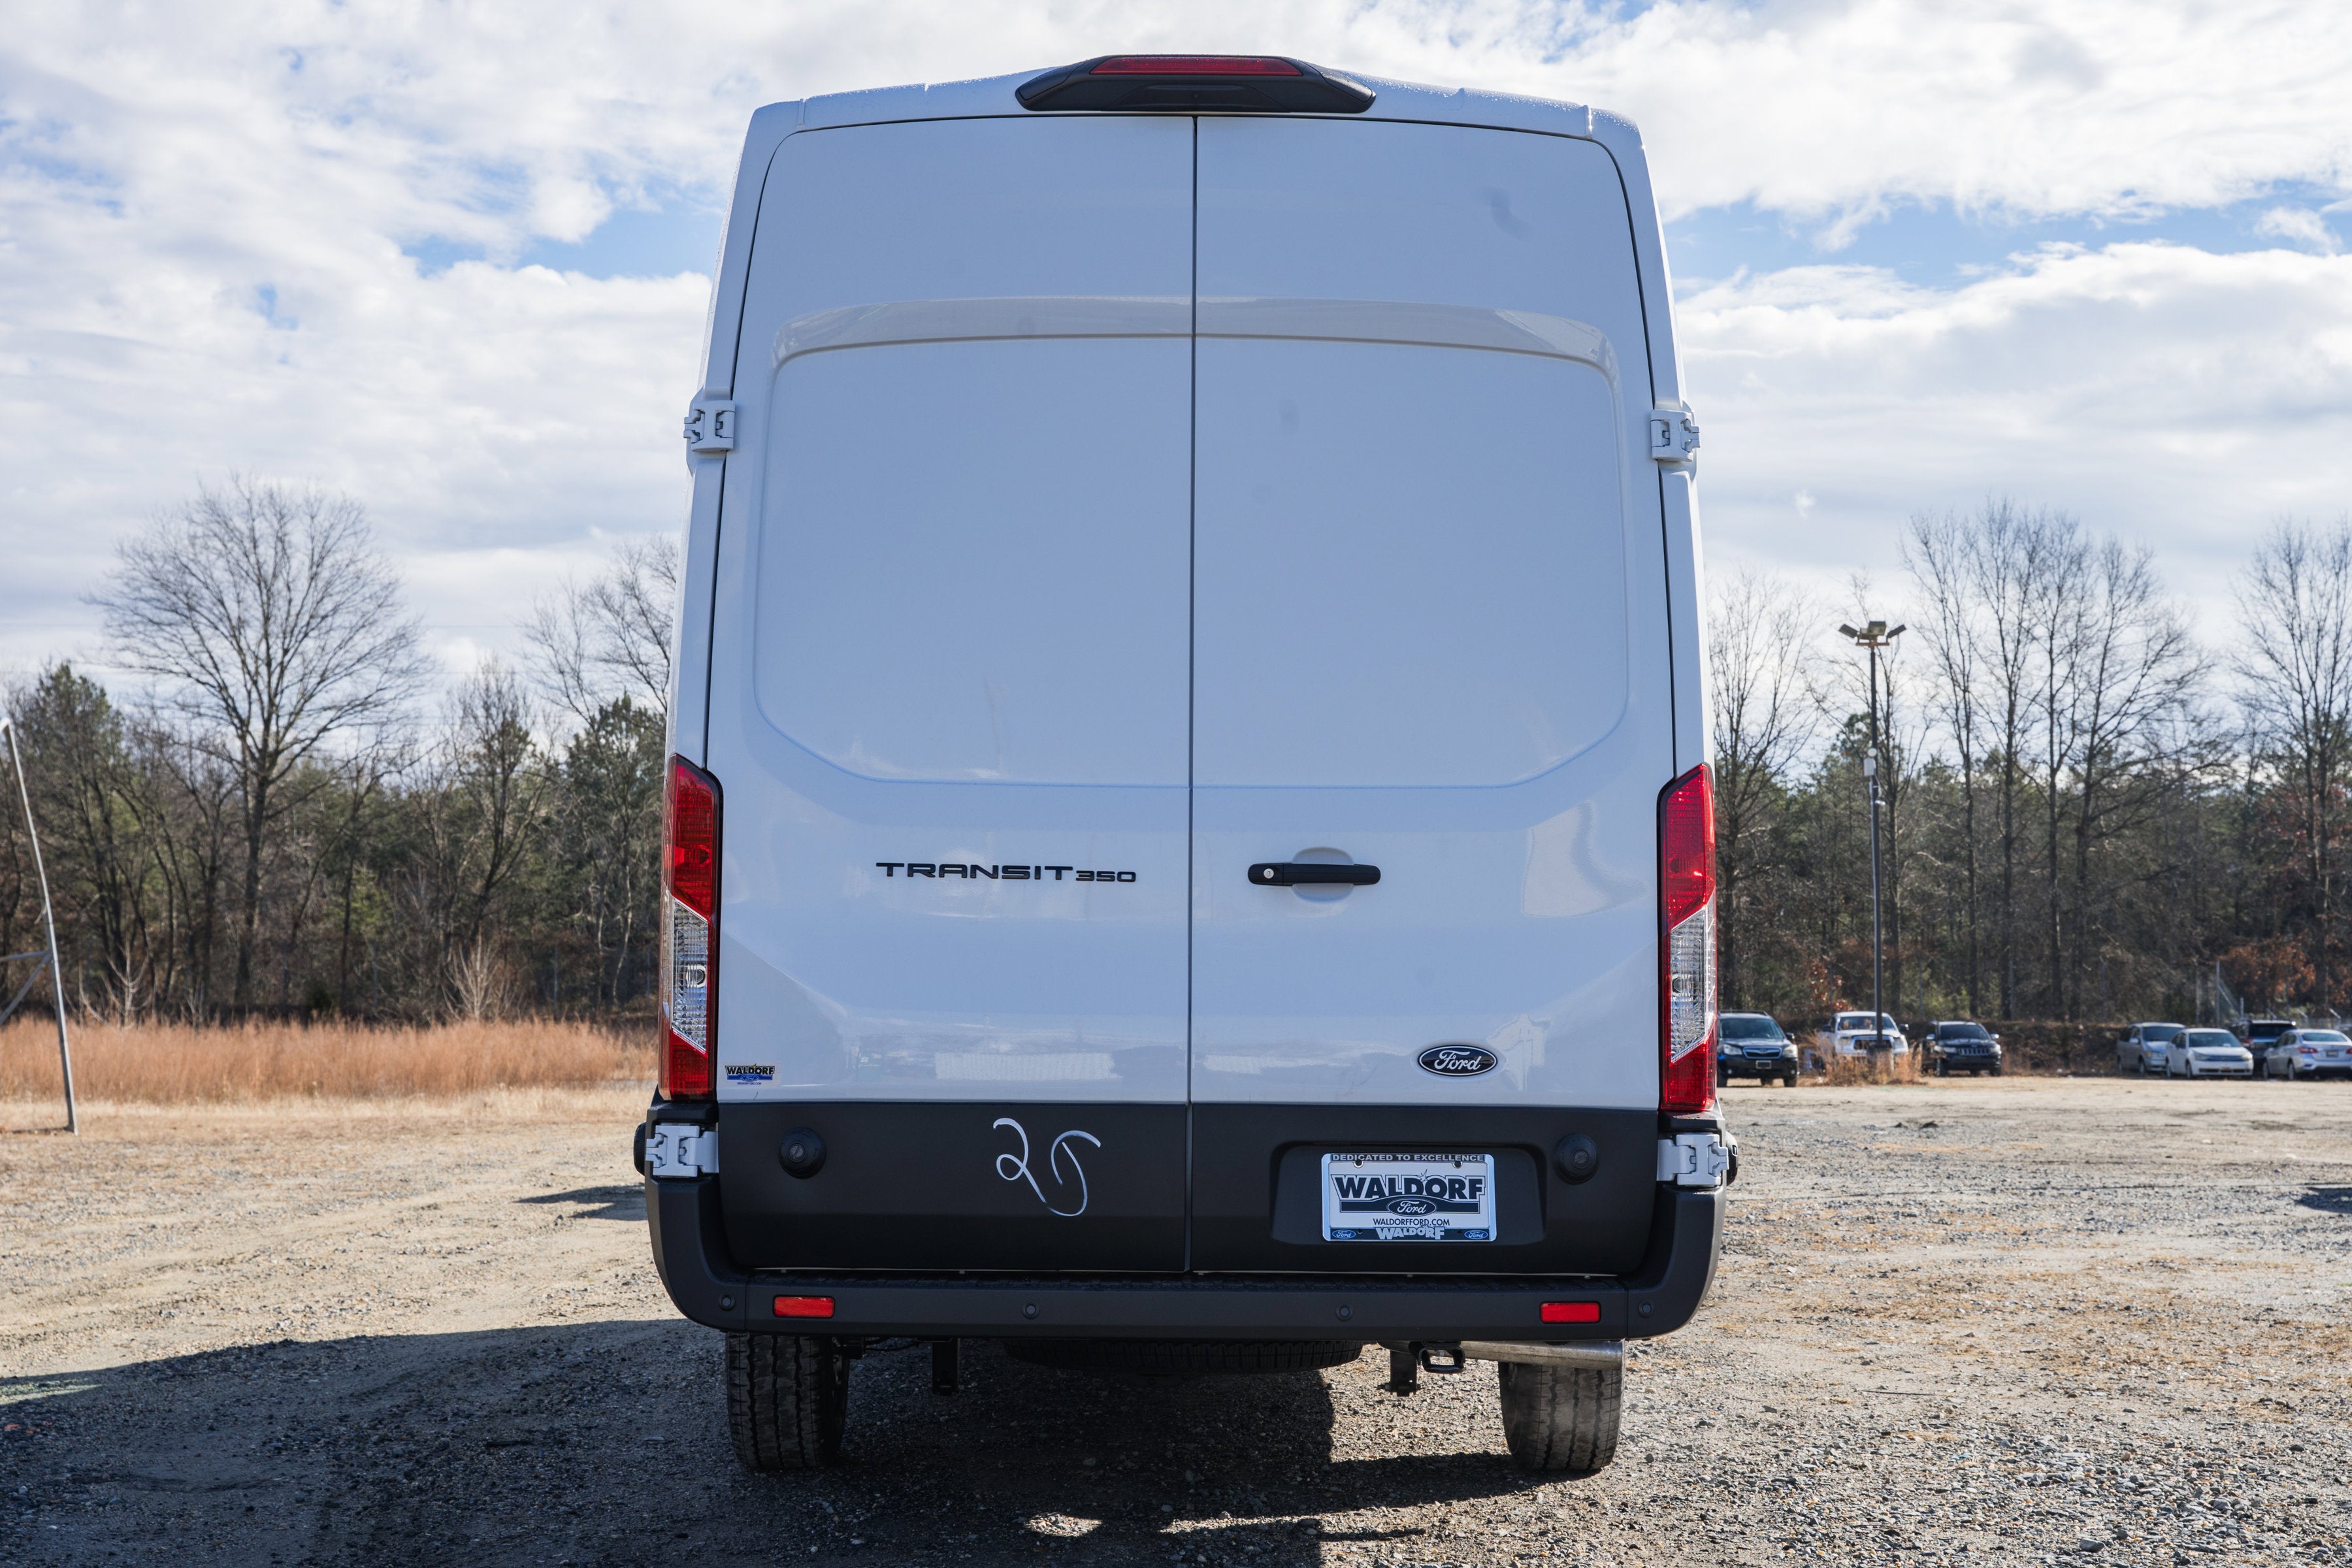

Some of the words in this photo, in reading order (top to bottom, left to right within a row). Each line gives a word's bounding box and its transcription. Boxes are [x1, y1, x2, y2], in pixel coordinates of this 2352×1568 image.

[875, 862, 1073, 881] TRANSIT
[1075, 870, 1136, 883] 350
[1433, 1049, 1482, 1070] Ford
[726, 1066, 774, 1075] WALDORF
[1333, 1175, 1484, 1200] WALDORF
[1397, 1200, 1427, 1214] Ford
[1335, 1229, 1352, 1238] Ford
[1375, 1226, 1445, 1240] WALDORF
[1467, 1230, 1484, 1239] Ford
